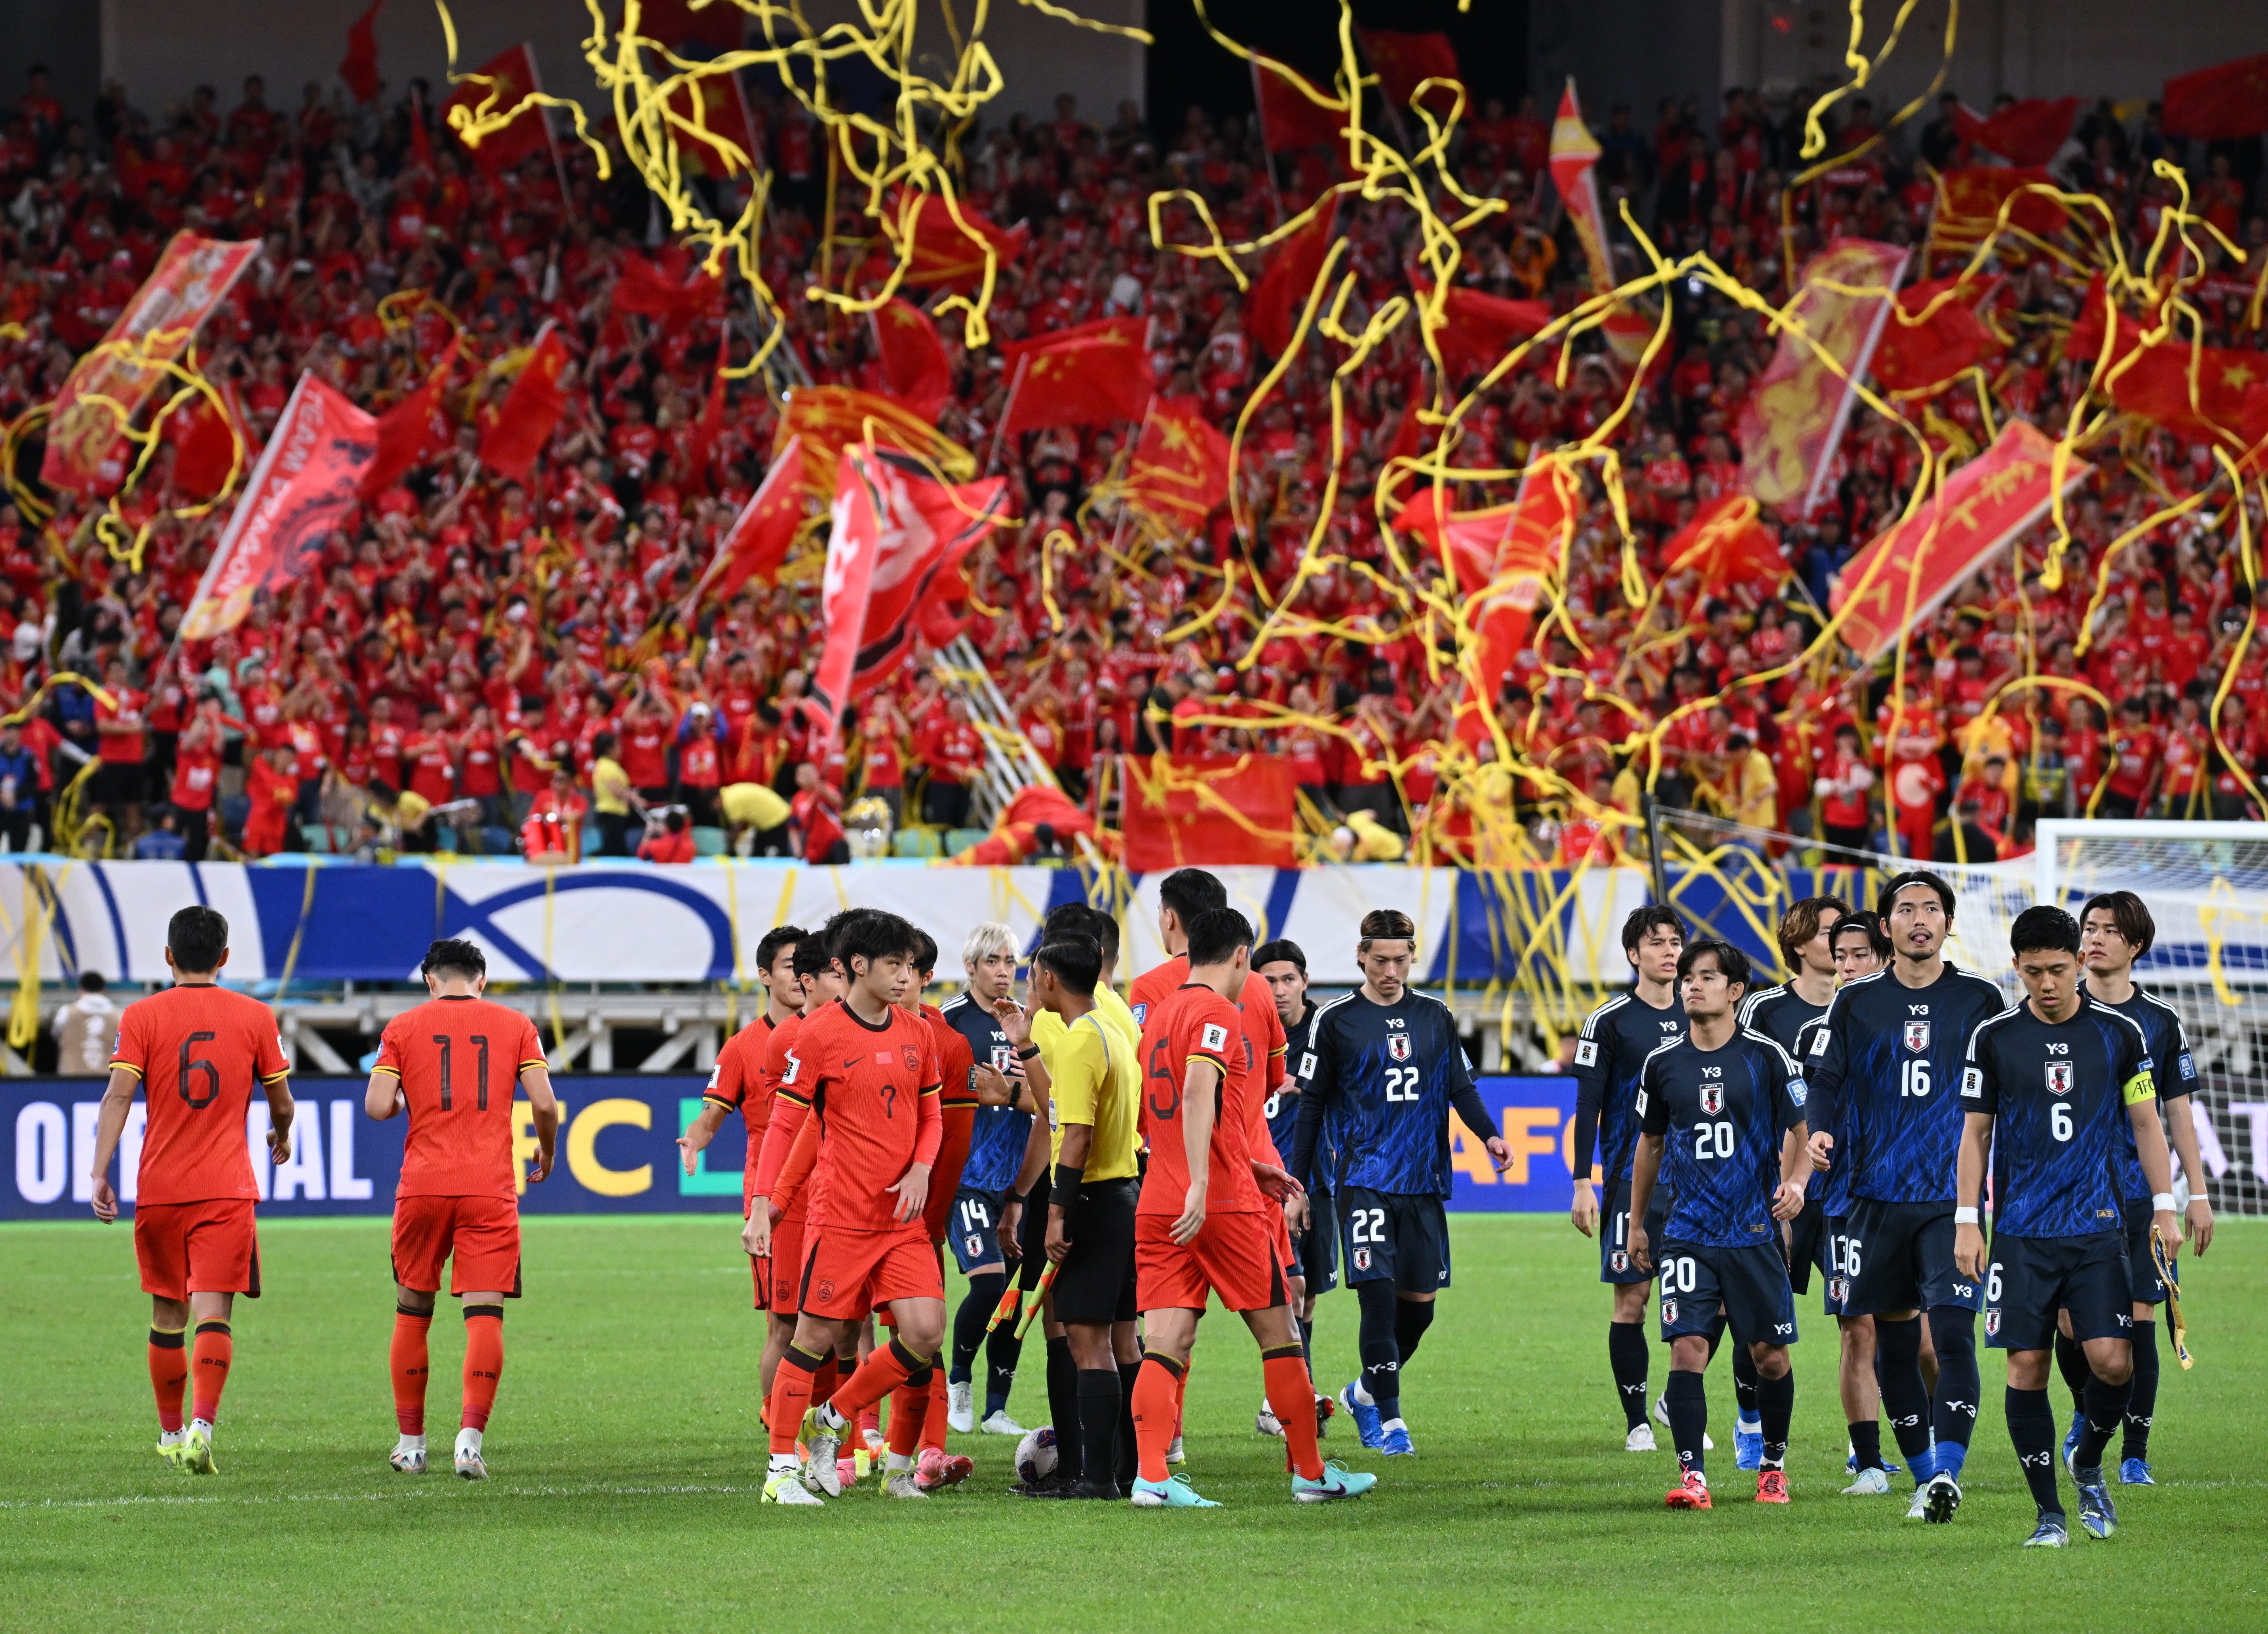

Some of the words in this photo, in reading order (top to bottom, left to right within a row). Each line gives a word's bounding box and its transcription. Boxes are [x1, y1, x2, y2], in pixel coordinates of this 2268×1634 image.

[1908, 1005, 1929, 1015] Y-3
[1386, 1018, 1405, 1028] Y-3
[1660, 1021, 1678, 1032] Y-3
[990, 1031, 1007, 1041] Y-3
[2046, 1043, 2069, 1055] Y-3
[179, 1032, 220, 1109] 6
[433, 1035, 488, 1111] 11
[1149, 1036, 1180, 1120] 5
[1701, 1067, 1721, 1078] Y-3
[1901, 1060, 1930, 1096] 16
[1385, 1066, 1419, 1102] 22
[2051, 1102, 2073, 1142] 6
[512, 1098, 652, 1197] FC
[1694, 1122, 1734, 1159] 20
[961, 1199, 990, 1232] 14
[1352, 1208, 1385, 1243] 22
[1844, 1237, 1862, 1277] 16
[1329, 1271, 1337, 1282] Y-3
[1661, 1257, 1696, 1296] 20
[1987, 1263, 2003, 1302] 6
[1952, 1284, 1972, 1298] Y-3
[1774, 1323, 1792, 1335] Y-3
[2116, 1314, 2133, 1328] Y-3
[1367, 1361, 1397, 1374] Y-3
[1623, 1381, 1646, 1395] Y-3
[1945, 1400, 1976, 1418] Y-3
[1888, 1414, 1918, 1429] Y-3
[2126, 1412, 2152, 1427] Y-3
[2021, 1451, 2049, 1468] Y-3
